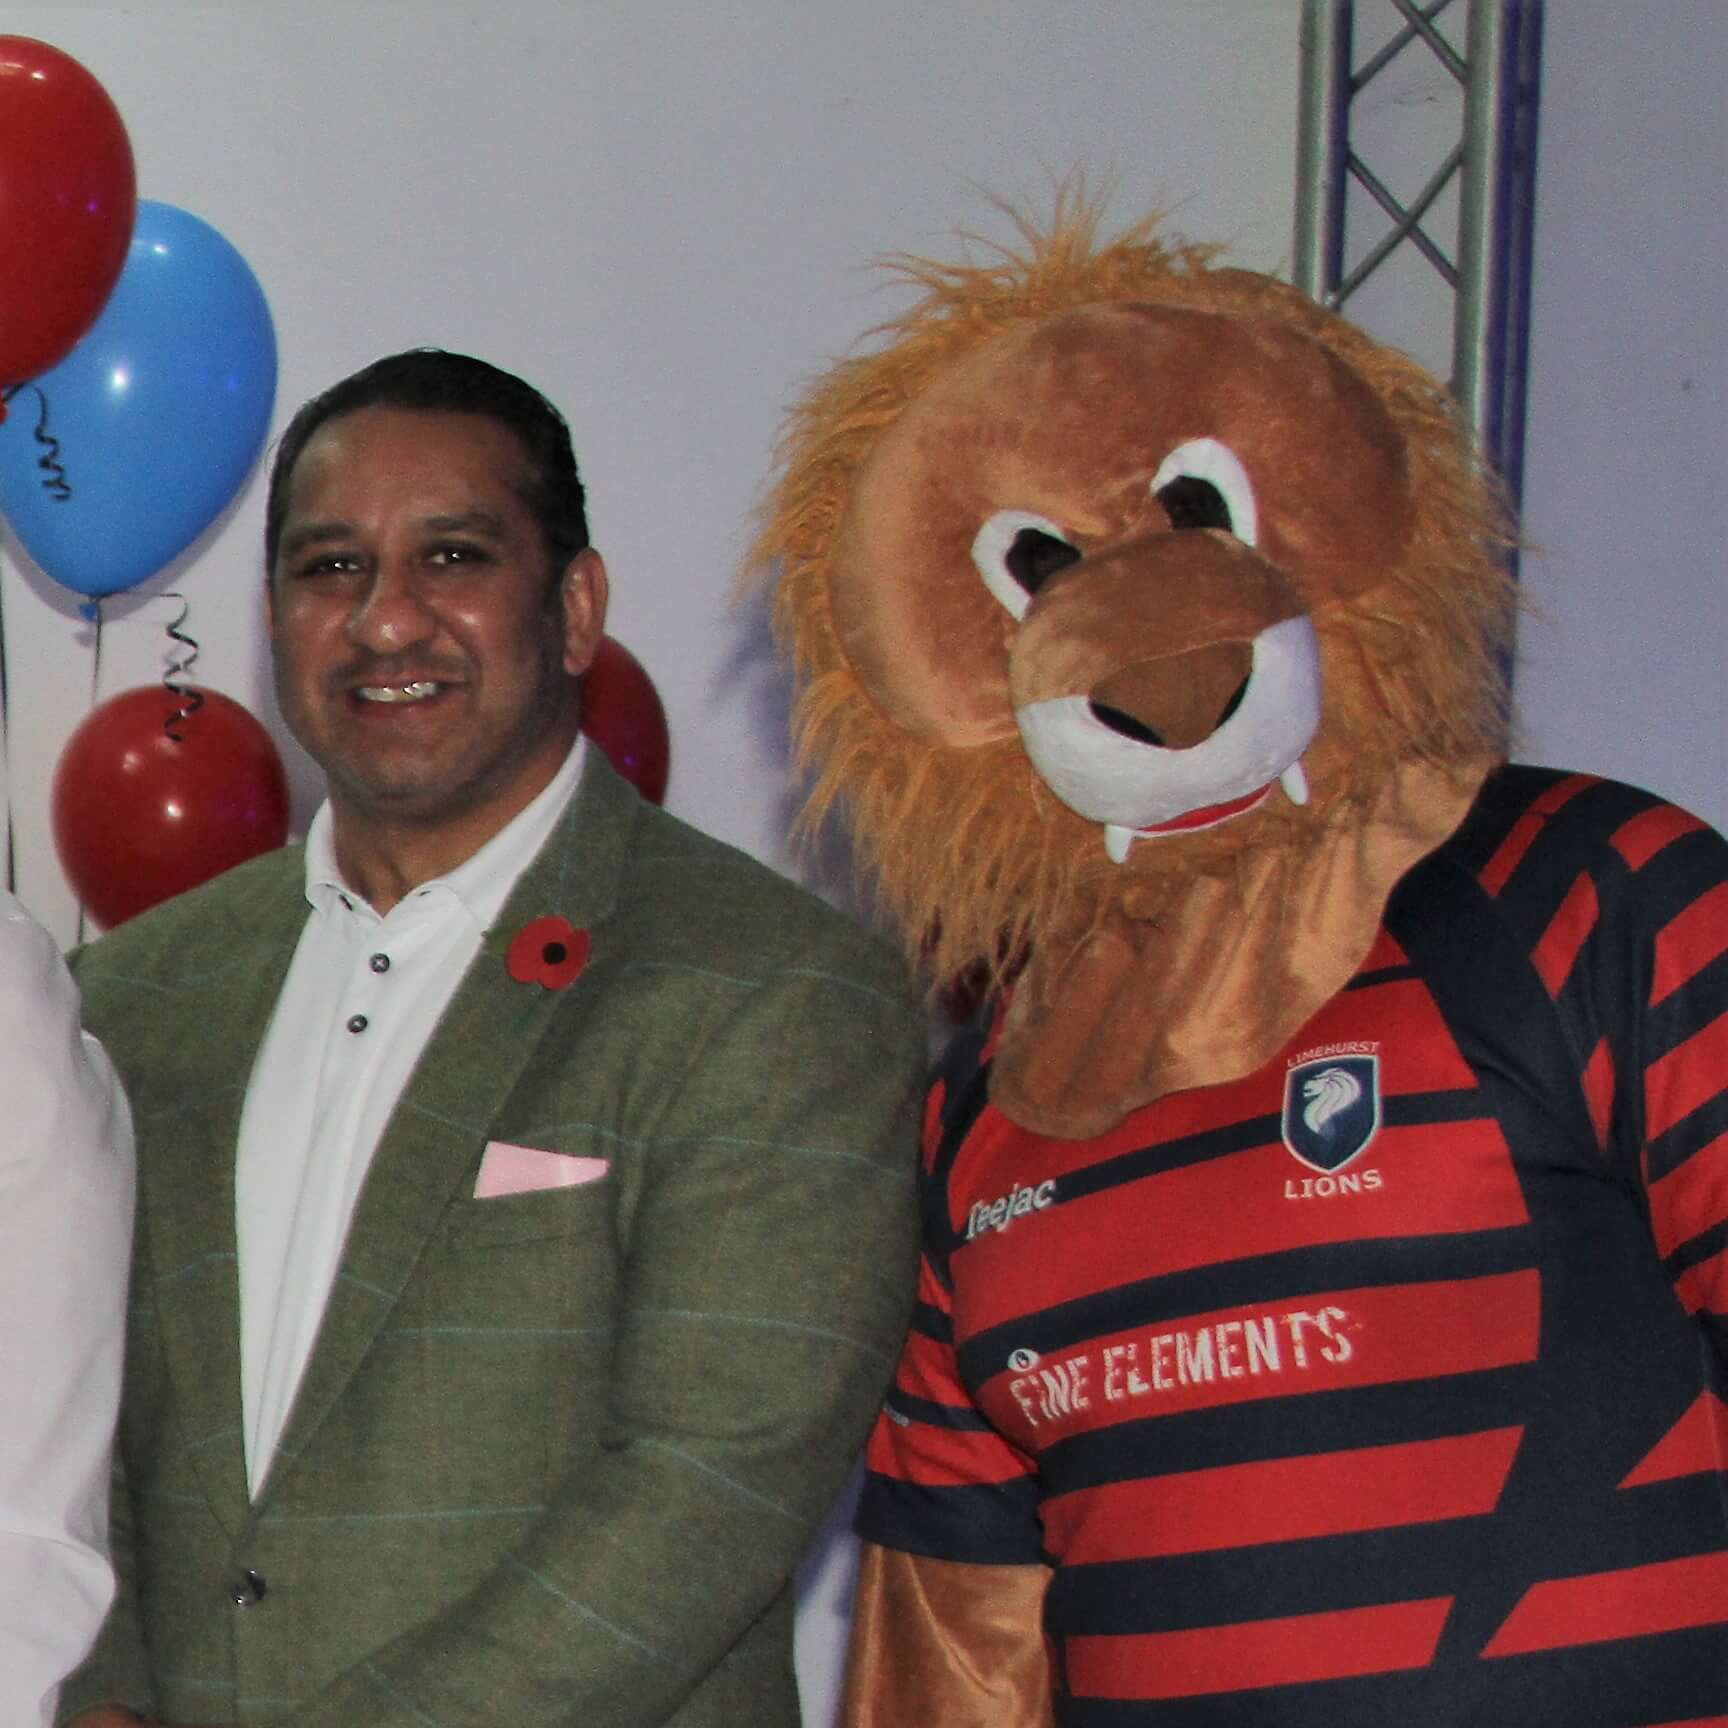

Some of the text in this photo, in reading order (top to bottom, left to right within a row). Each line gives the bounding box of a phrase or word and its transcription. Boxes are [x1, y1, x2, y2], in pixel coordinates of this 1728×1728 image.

[1287, 1041, 1381, 1068] LIMEHURST
[1284, 1169, 1383, 1200] LIONS
[1102, 1306, 1352, 1401] ELEMENTS
